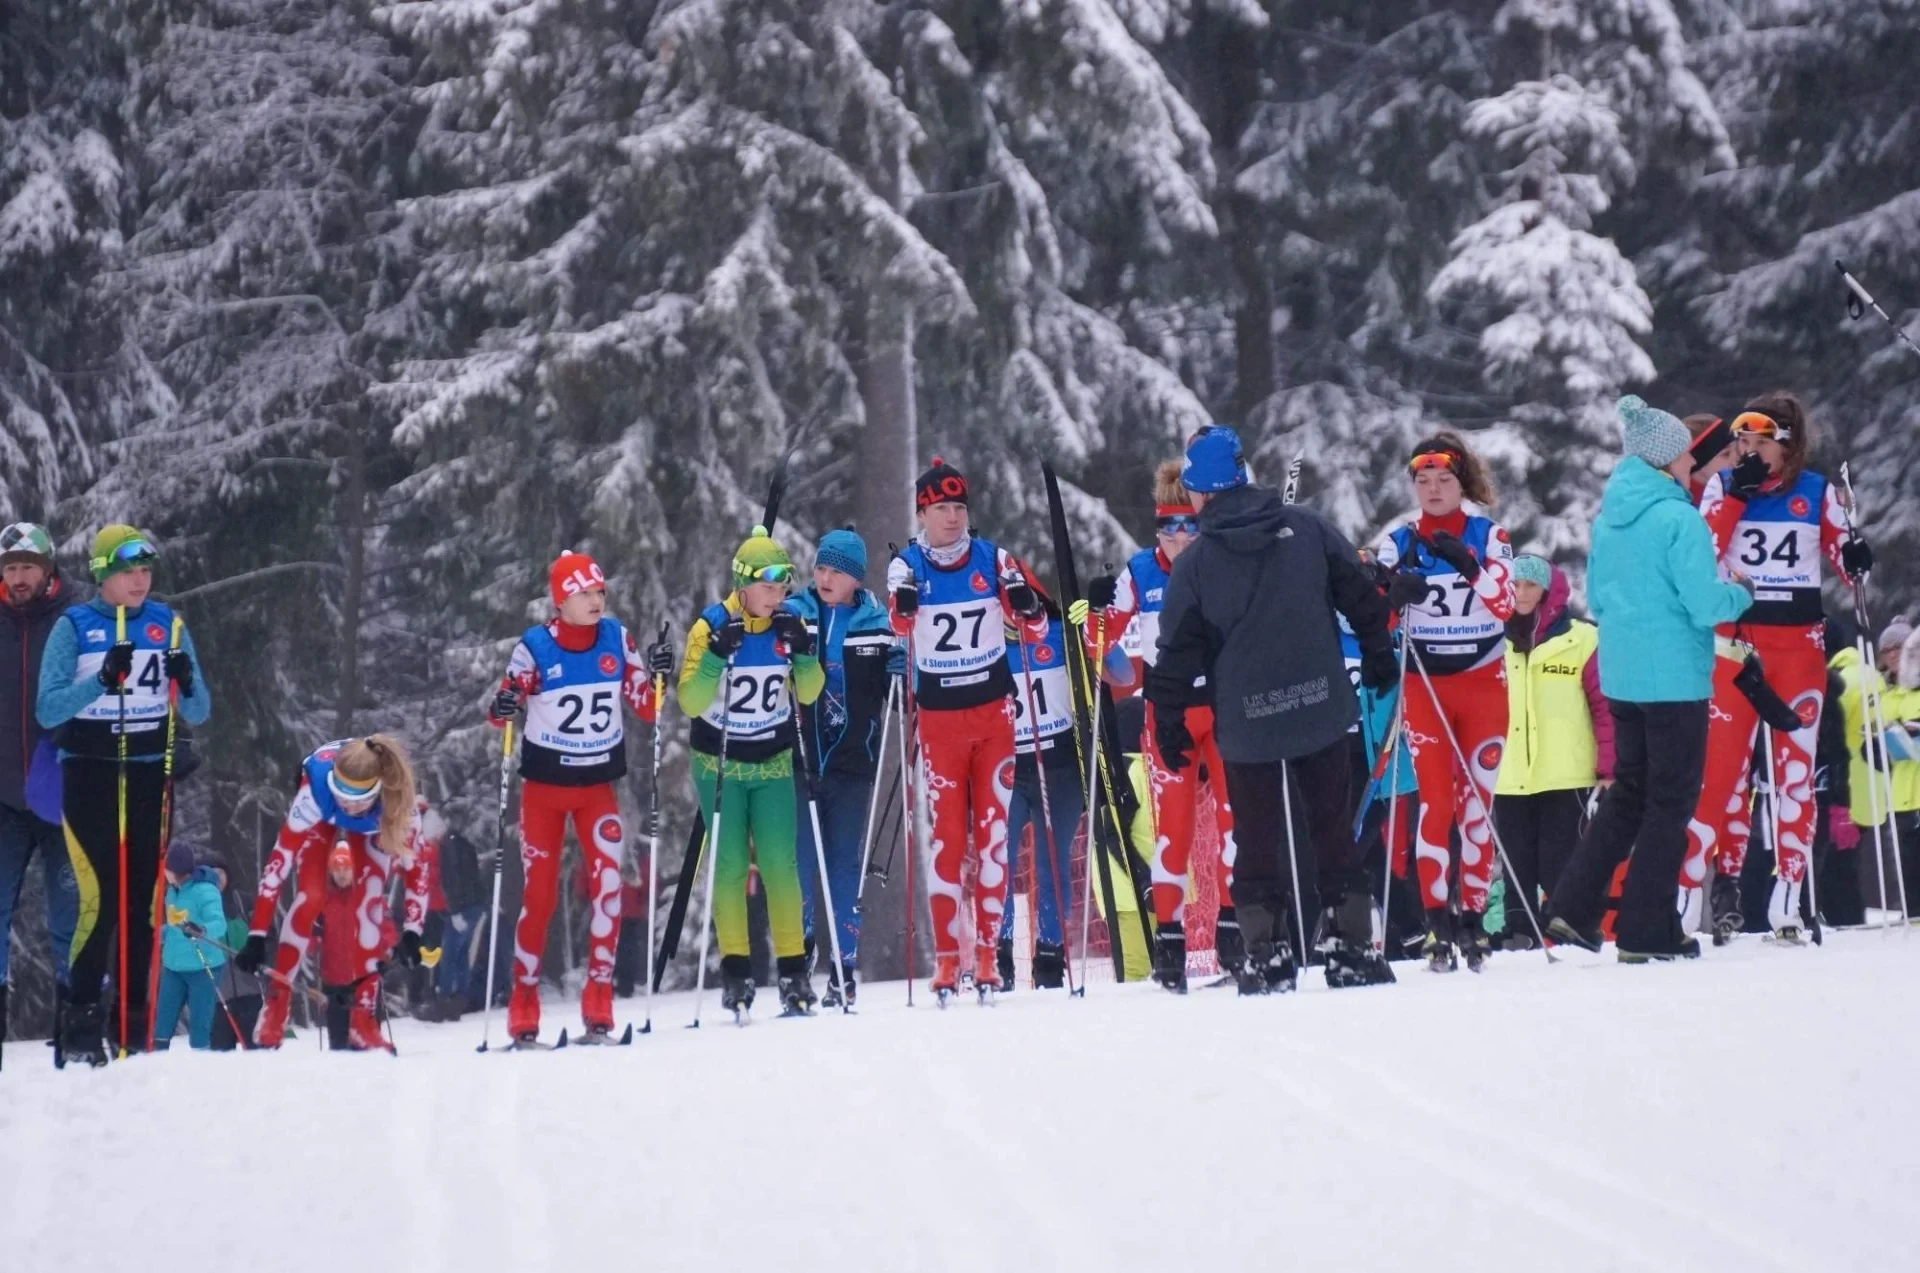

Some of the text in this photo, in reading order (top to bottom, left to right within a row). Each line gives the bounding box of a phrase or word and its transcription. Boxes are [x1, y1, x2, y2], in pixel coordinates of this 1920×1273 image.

[1740, 528, 1801, 568] 34
[1428, 582, 1476, 617] 37
[933, 606, 987, 652] 27
[1447, 625, 1479, 635] Karlovy
[929, 658, 959, 669] Slovan
[1542, 663, 1578, 675] kalas
[728, 673, 784, 713] 26
[1268, 676, 1329, 703] SLOVAN
[557, 691, 613, 734] 25
[551, 735, 580, 748] Slovan
